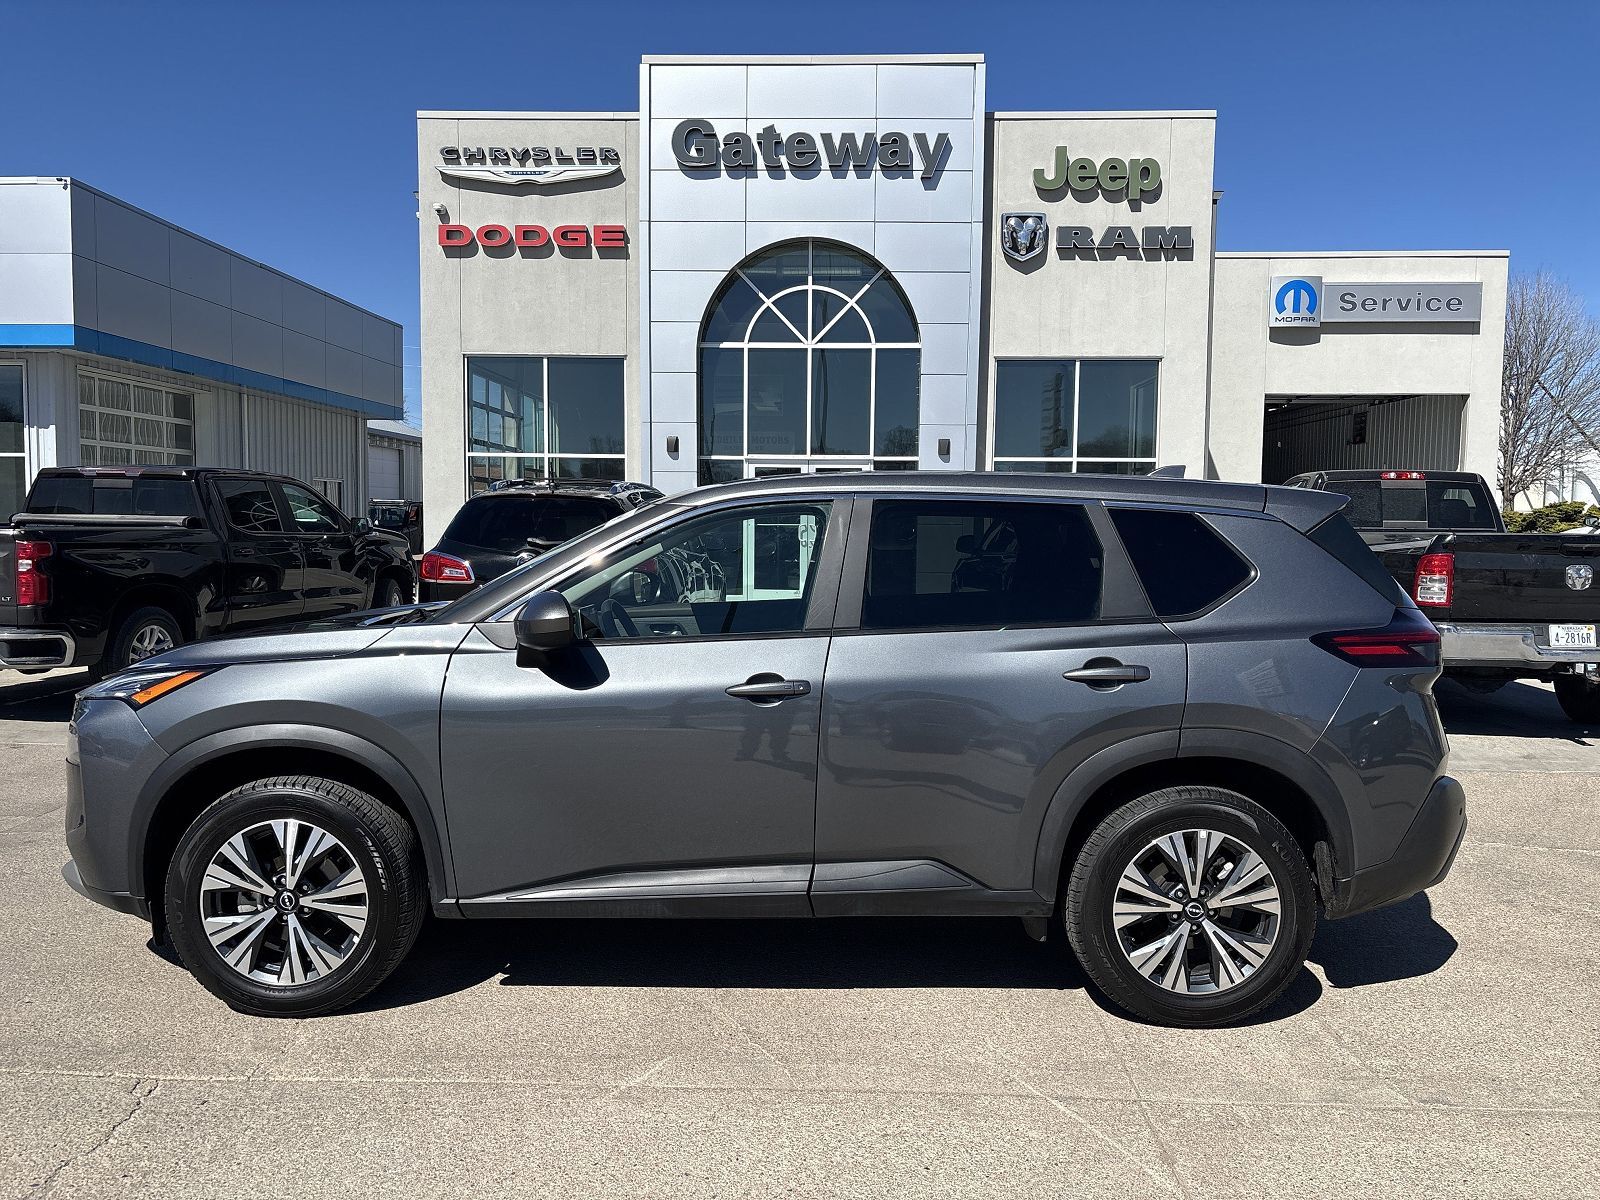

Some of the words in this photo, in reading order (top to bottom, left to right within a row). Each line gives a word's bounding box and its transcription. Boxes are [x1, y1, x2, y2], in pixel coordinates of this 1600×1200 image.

[439, 145, 619, 160] CHRYSLER
[671, 118, 950, 180] Gateway
[1033, 145, 1161, 200] Jeep
[438, 224, 625, 247] DODGE
[1056, 226, 1193, 249] RAM
[1339, 292, 1463, 312] Service
[1555, 632, 1592, 644] 4-2816R
